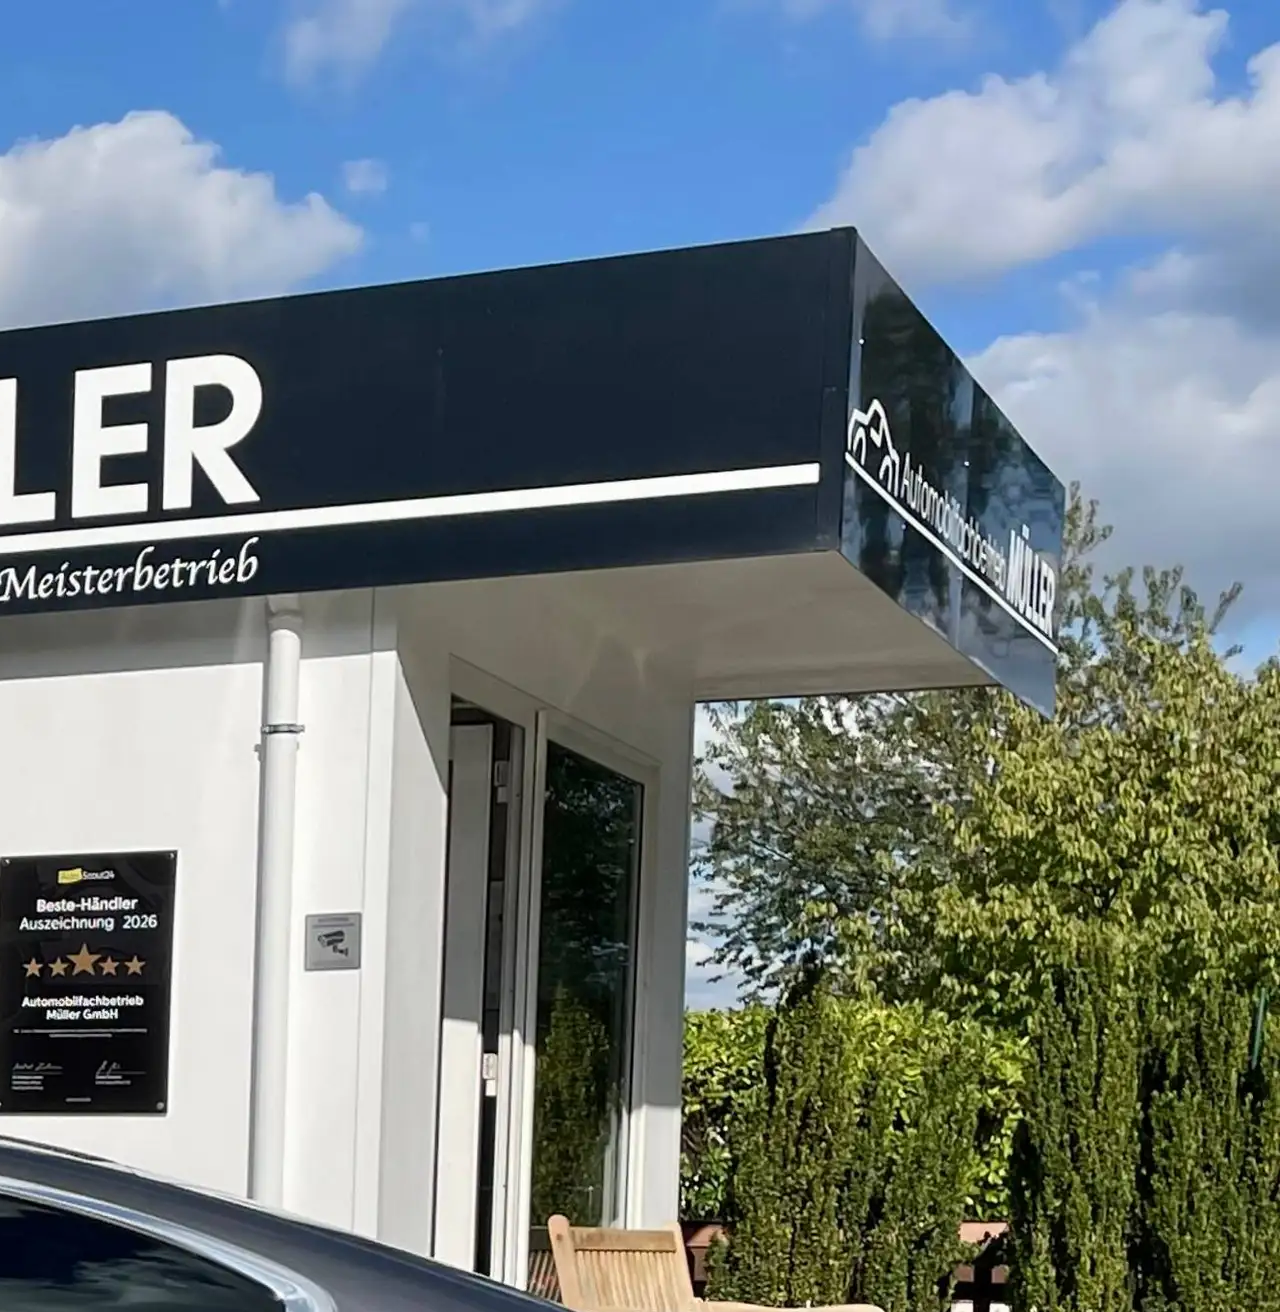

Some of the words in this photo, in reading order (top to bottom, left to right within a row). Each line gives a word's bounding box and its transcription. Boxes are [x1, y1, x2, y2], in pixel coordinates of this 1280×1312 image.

[1006, 523, 1056, 638] MÜLLER
[36, 896, 139, 912] Beste-Händler
[19, 916, 115, 931] Auszeichnung
[122, 914, 158, 929] 2026
[21, 994, 144, 1008] Automobilfachbetrieb
[46, 1008, 82, 1020] Müller
[82, 1008, 119, 1020] GmbH
